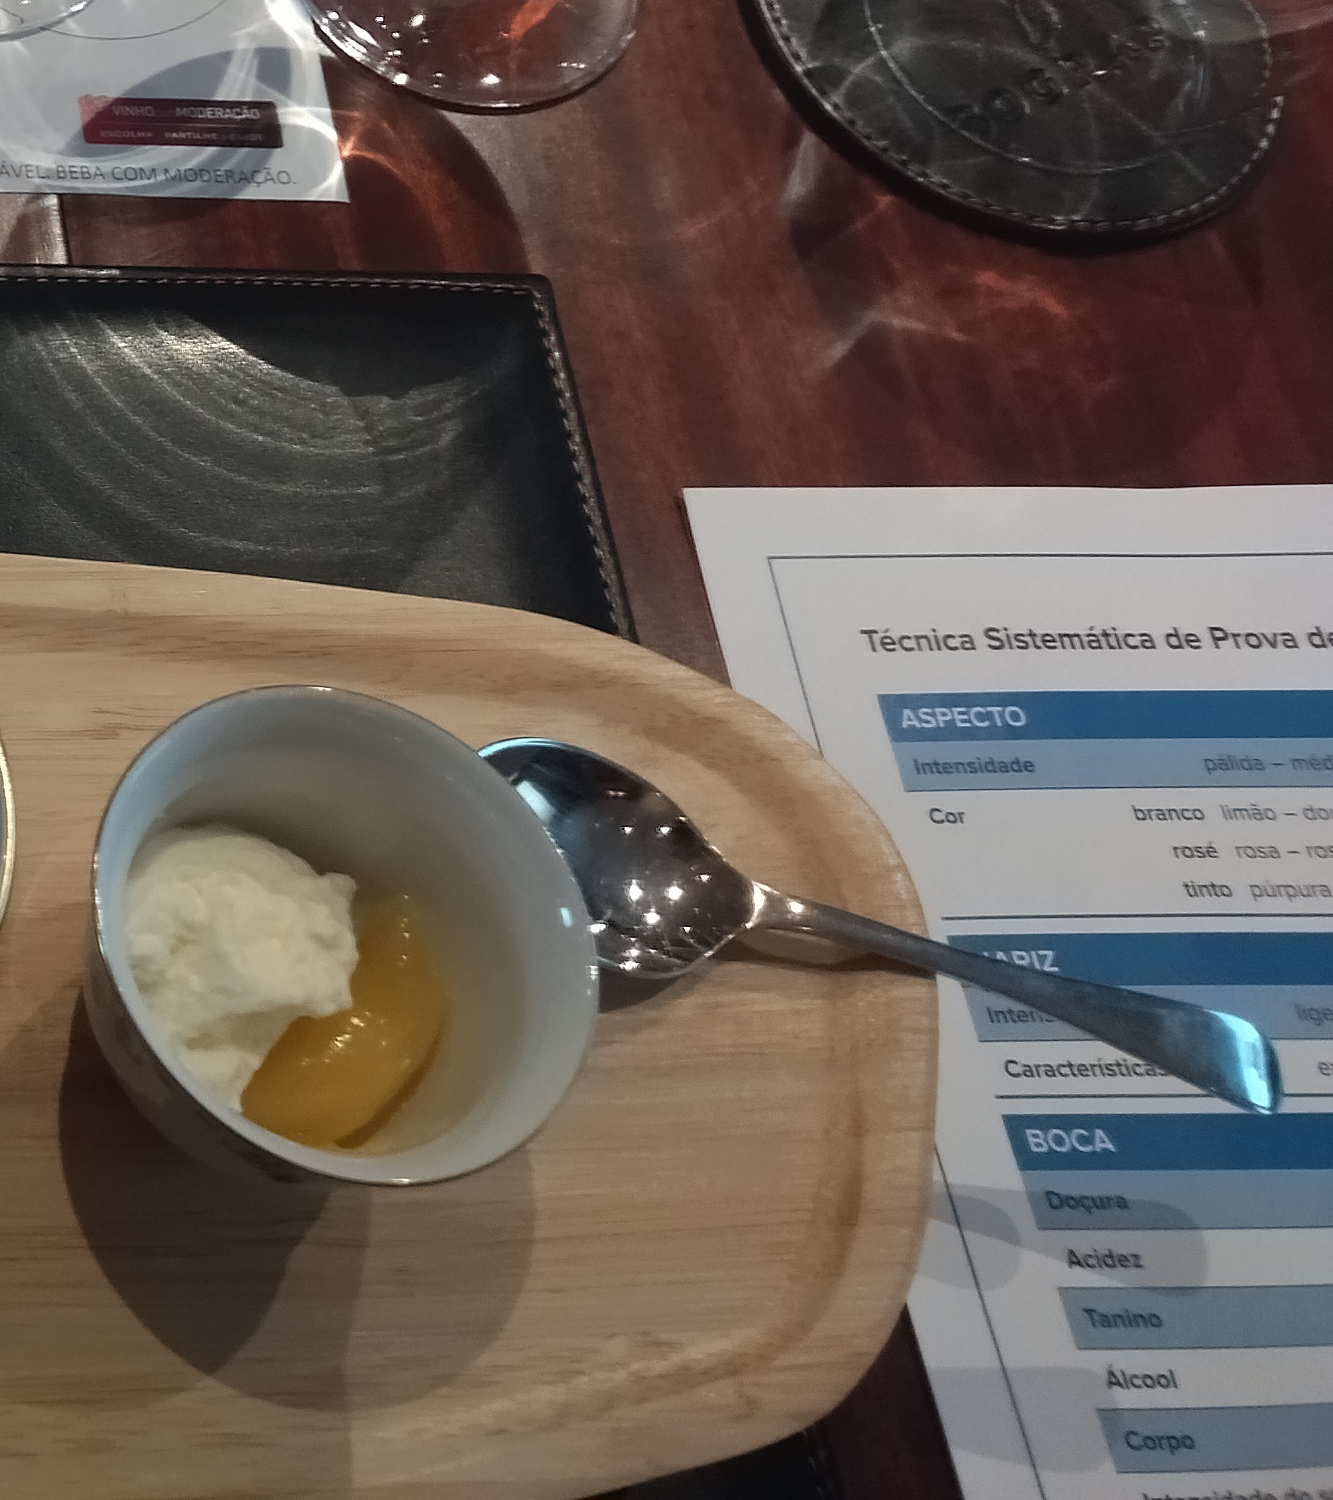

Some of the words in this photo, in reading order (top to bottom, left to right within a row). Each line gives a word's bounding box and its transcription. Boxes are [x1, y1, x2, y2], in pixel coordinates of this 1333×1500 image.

[112, 105, 155, 118] VINHO
[174, 105, 261, 122] MODERAÇÃO
[56, 164, 105, 181] BEBA
[110, 165, 158, 183] COM
[163, 167, 297, 187] MODERAÇÃO.
[859, 627, 976, 653] Técnica
[983, 625, 1157, 651] Sistemática
[1165, 626, 1203, 650] de
[1207, 626, 1300, 650] Prova
[900, 705, 1028, 730] ASPECTO
[913, 755, 1035, 776] Intensidade
[1203, 753, 1267, 776] pálida
[928, 807, 966, 825] Cor
[1131, 804, 1206, 823] branco
[1219, 802, 1278, 822] limão
[1172, 840, 1221, 860] rosé
[1234, 844, 1282, 860] rosa
[1182, 879, 1234, 899] tinto
[1024, 1127, 1117, 1154] BOCA
[1045, 1189, 1130, 1214] Doçura
[1066, 1247, 1145, 1270] Acidez
[1082, 1307, 1164, 1329] Tanino
[1106, 1362, 1179, 1390] Álcool
[1124, 1429, 1197, 1456] Corpo
